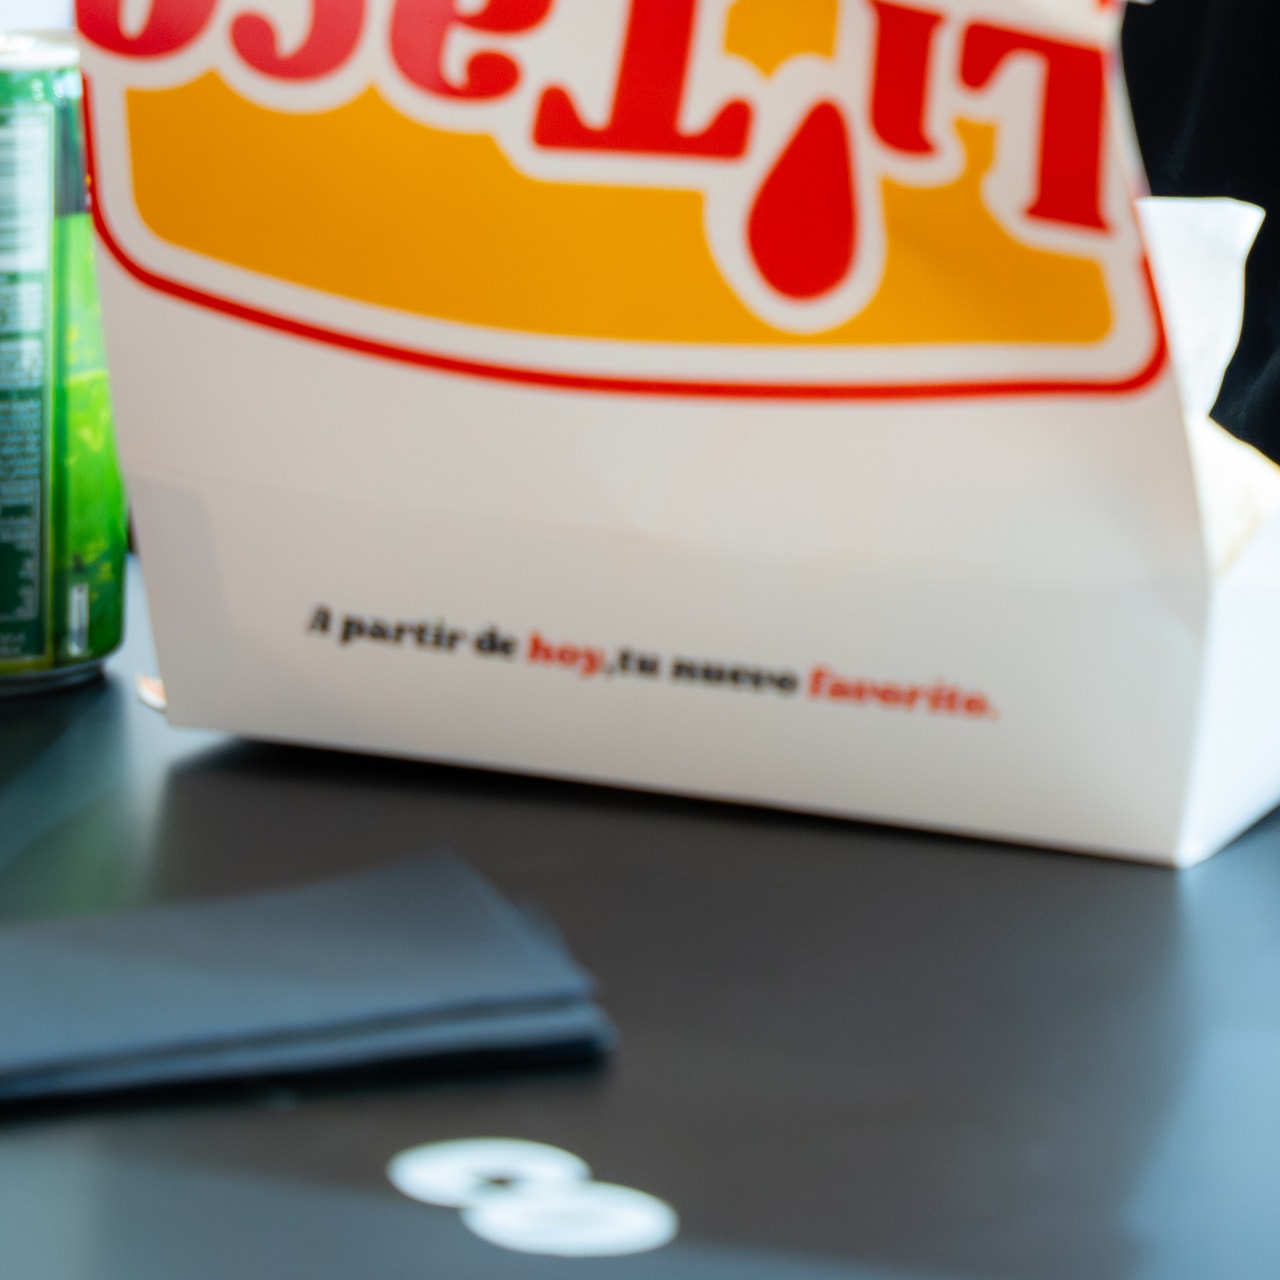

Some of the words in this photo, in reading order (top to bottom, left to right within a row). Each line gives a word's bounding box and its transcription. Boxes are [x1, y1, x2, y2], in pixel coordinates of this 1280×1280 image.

[338, 612, 466, 653] partir
[471, 624, 519, 659] de
[669, 655, 801, 696] nuevo
